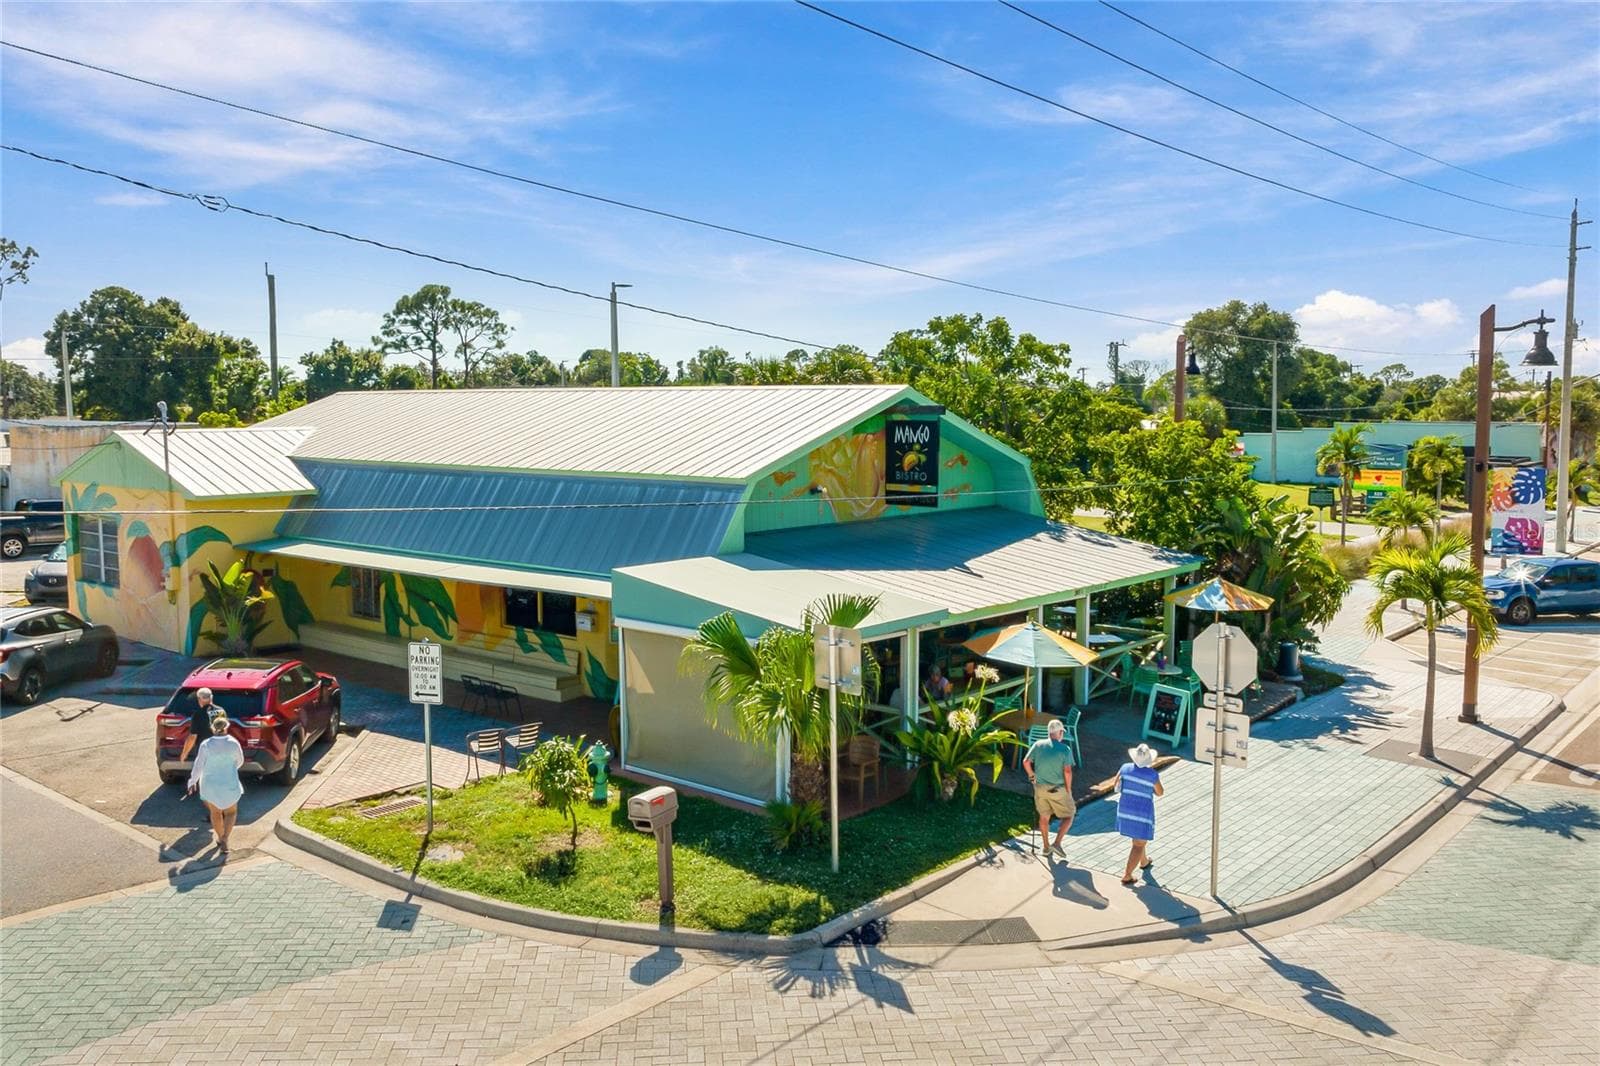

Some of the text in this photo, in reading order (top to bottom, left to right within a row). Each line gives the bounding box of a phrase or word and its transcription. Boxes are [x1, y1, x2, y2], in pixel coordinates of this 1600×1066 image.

[894, 424, 930, 444] MANGO
[895, 471, 928, 481] BISTRO
[419, 646, 430, 655] NO
[410, 655, 440, 665] PARKING
